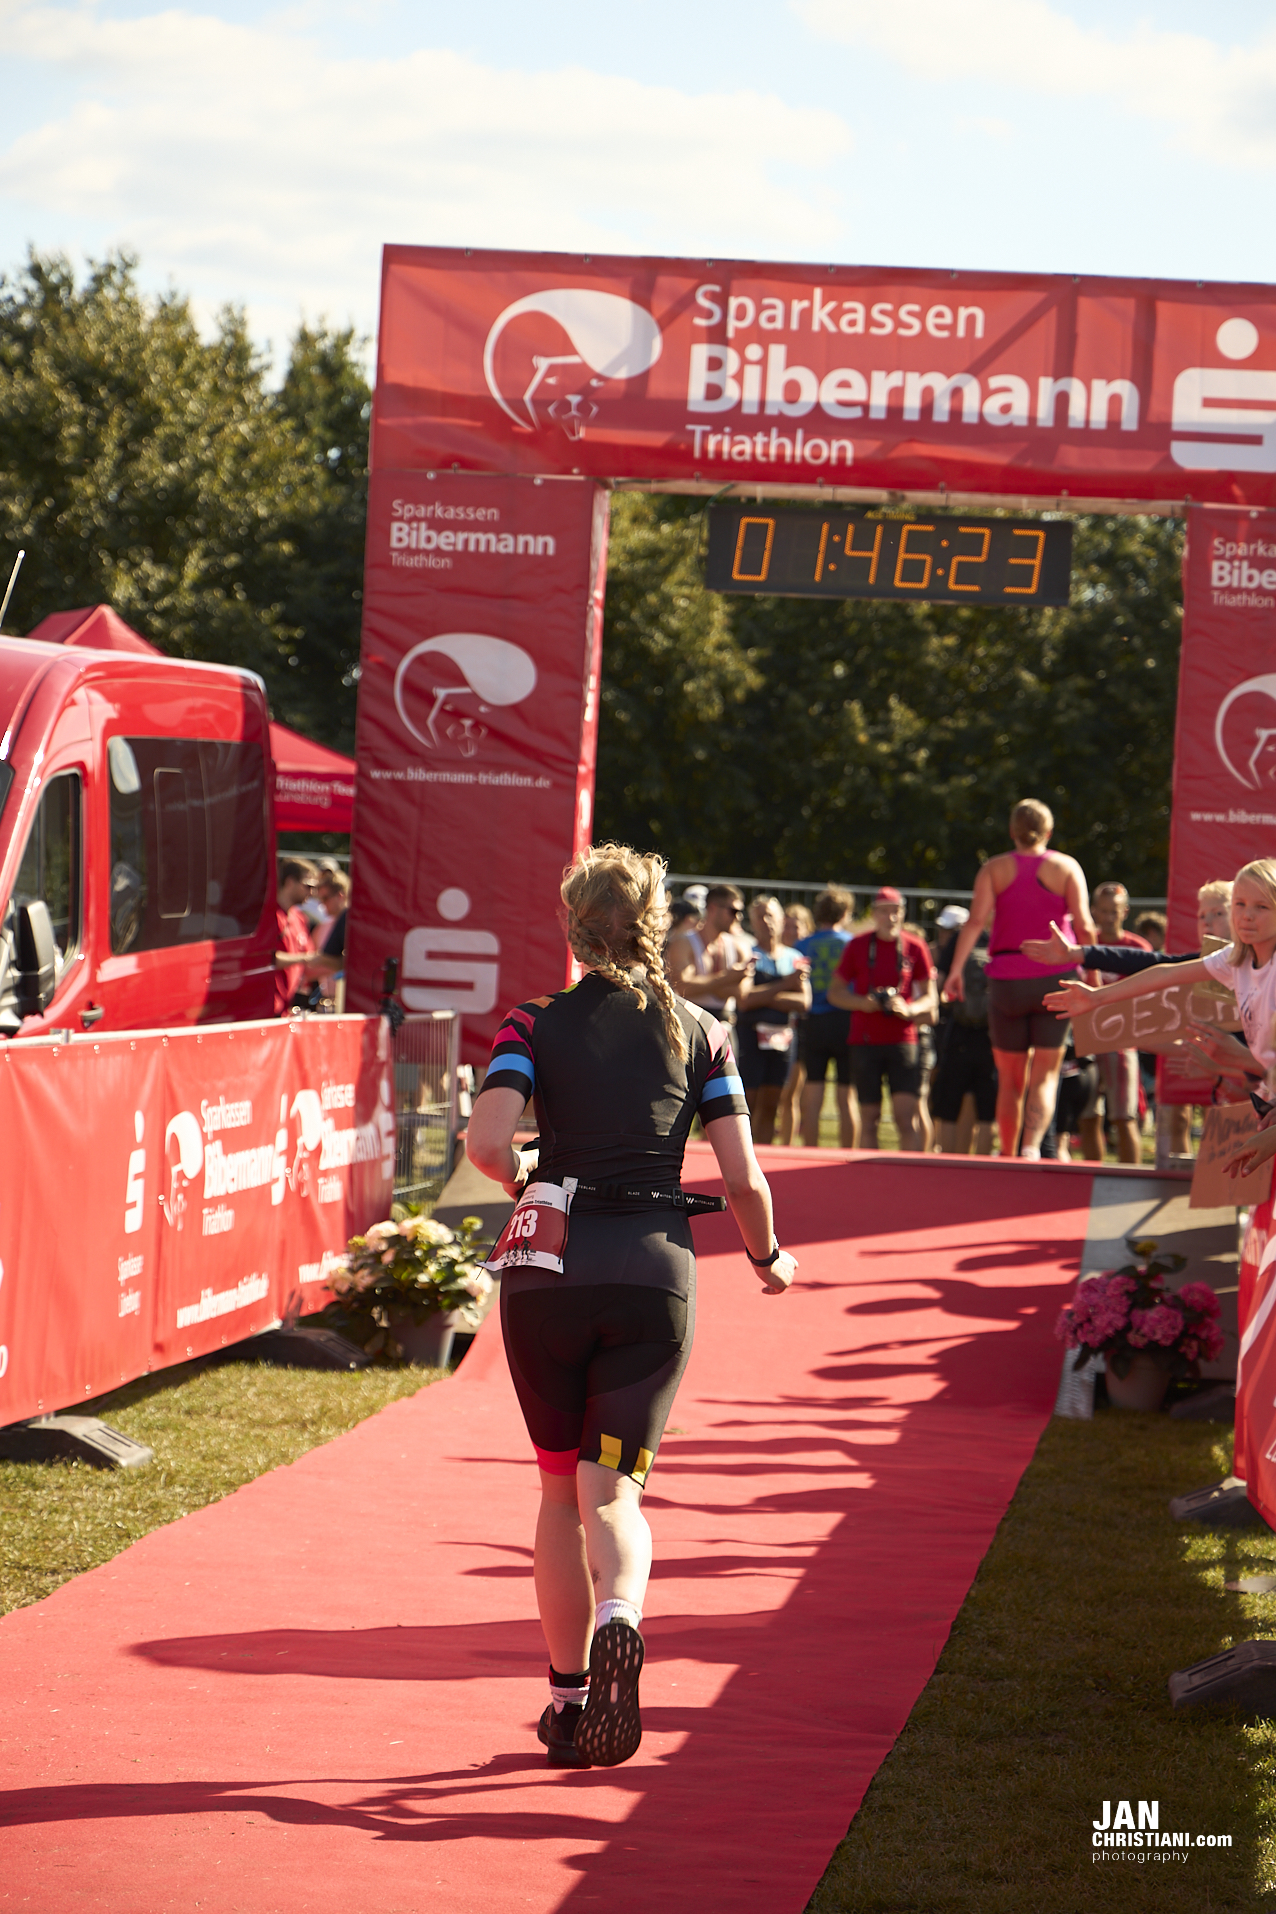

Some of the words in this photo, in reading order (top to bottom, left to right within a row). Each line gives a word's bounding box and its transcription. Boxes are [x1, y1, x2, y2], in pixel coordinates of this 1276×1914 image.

[692, 284, 985, 339] Sparkassen
[686, 343, 1140, 432] Bibermann
[685, 424, 854, 467] Triathlon
[391, 499, 500, 522] Sparkassen
[389, 521, 556, 556] Bibermann
[389, 552, 453, 569] Triathlon
[1211, 559, 1276, 590] Bibe
[1211, 589, 1276, 608] Triathlon
[370, 765, 552, 789] www.bibermann-triathlon.de
[201, 1095, 253, 1140] Sparkassen
[203, 1140, 275, 1200] Bibermann
[506, 1209, 539, 1243] 213
